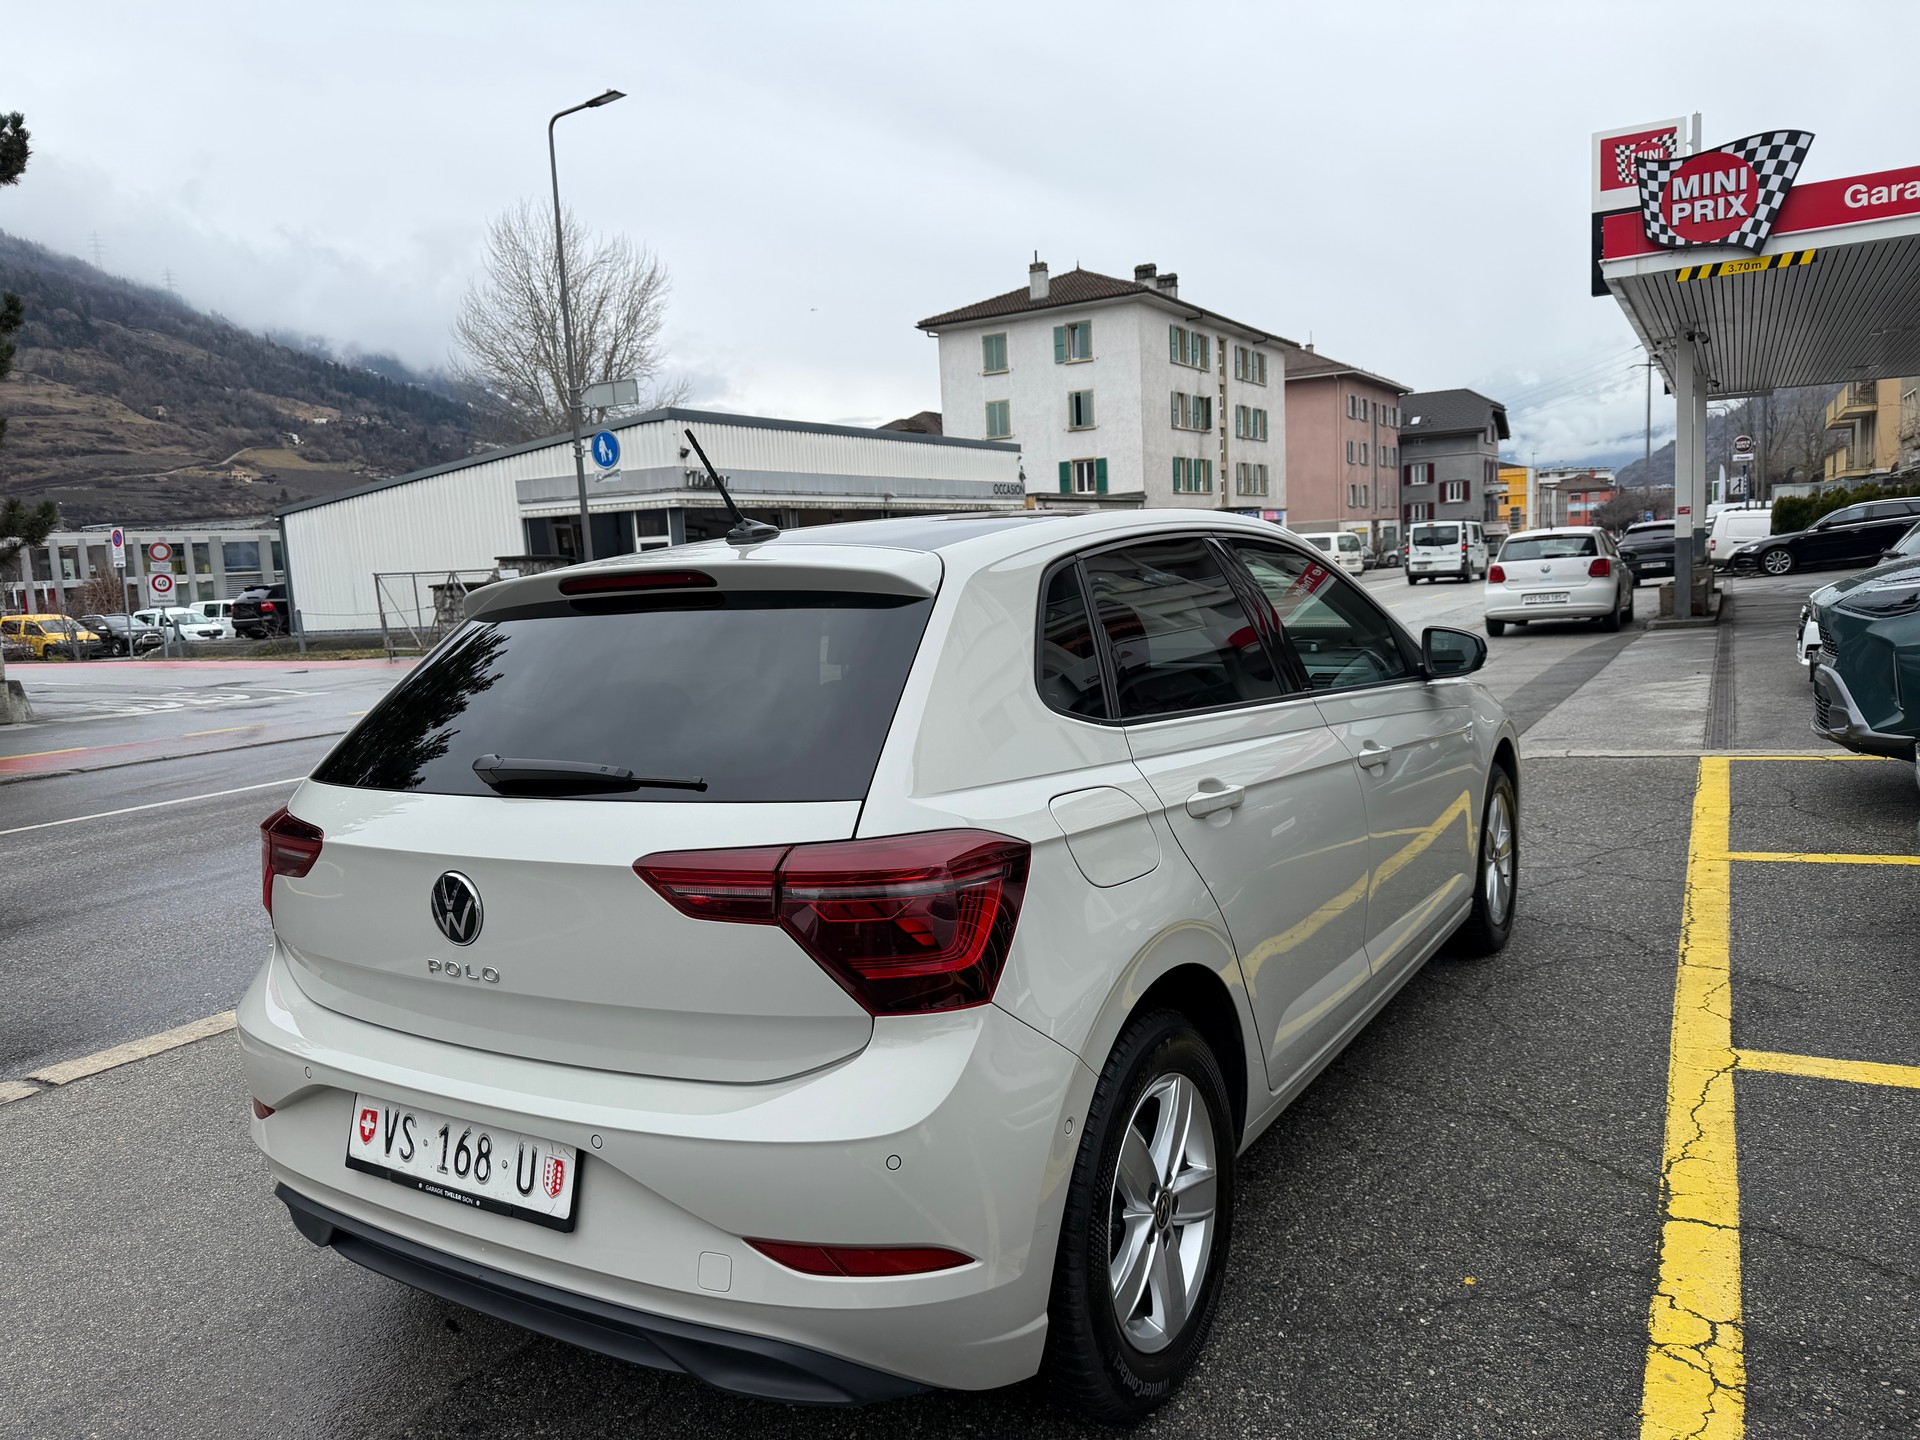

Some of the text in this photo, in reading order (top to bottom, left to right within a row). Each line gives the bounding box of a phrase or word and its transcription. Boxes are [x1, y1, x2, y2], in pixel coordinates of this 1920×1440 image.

[1672, 166, 1748, 201] MINI
[1844, 180, 1920, 209] Gara
[1671, 193, 1748, 226] PRIX
[685, 470, 731, 488] Theer
[993, 483, 1026, 495] OCCASION
[157, 579, 168, 587] 40
[427, 958, 500, 983] POLO
[384, 1106, 538, 1197] VS 168 U
